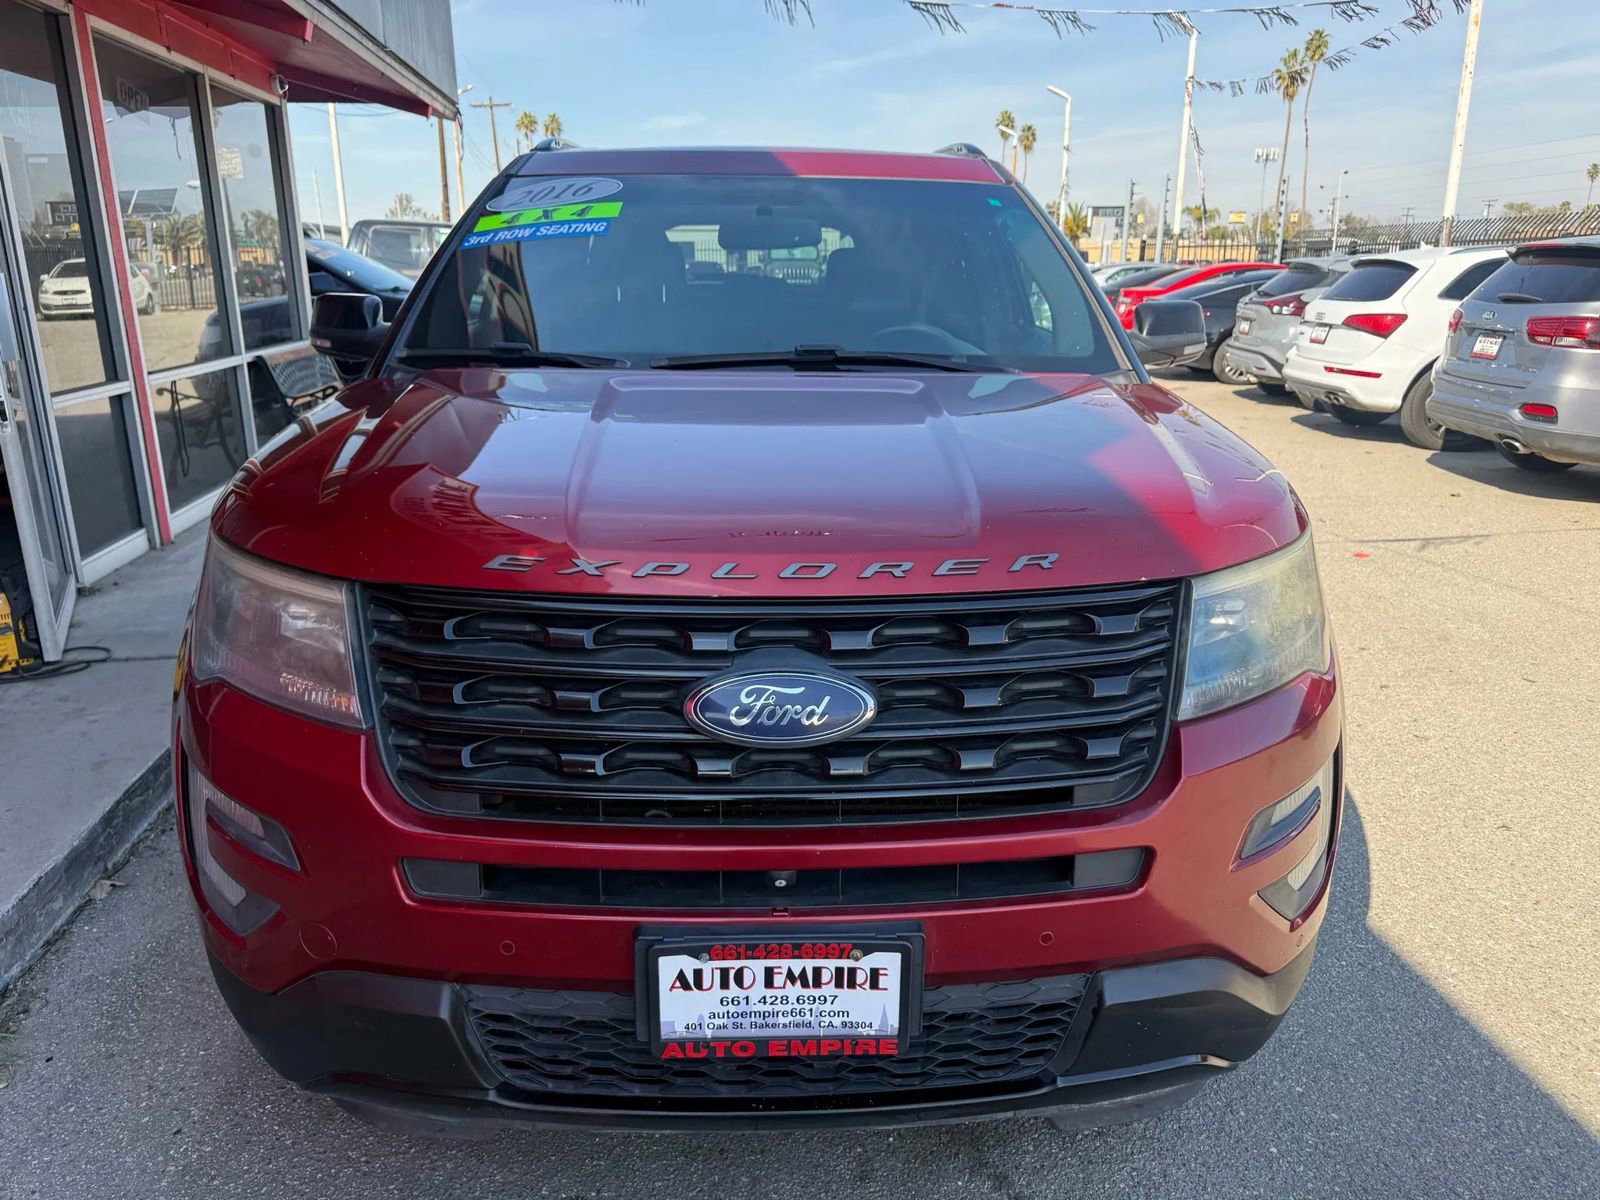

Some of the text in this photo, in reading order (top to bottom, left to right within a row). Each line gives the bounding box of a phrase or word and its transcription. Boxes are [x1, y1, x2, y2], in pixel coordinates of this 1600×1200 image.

[511, 182, 595, 206] 2016
[464, 222, 607, 247] 3rd ROW SEATING
[482, 552, 1060, 579] EXPLORER
[729, 684, 831, 727] Ford
[709, 943, 852, 960] 661-428-6997
[669, 965, 889, 992] AUTO EMPIRE
[719, 994, 839, 1008] 661.428.6997
[708, 1007, 850, 1021] autoempire661.com
[684, 1019, 874, 1032] 401 Oak St. Bakersfield, CA. 93304
[660, 1039, 898, 1059] AUTO EMPIRE
